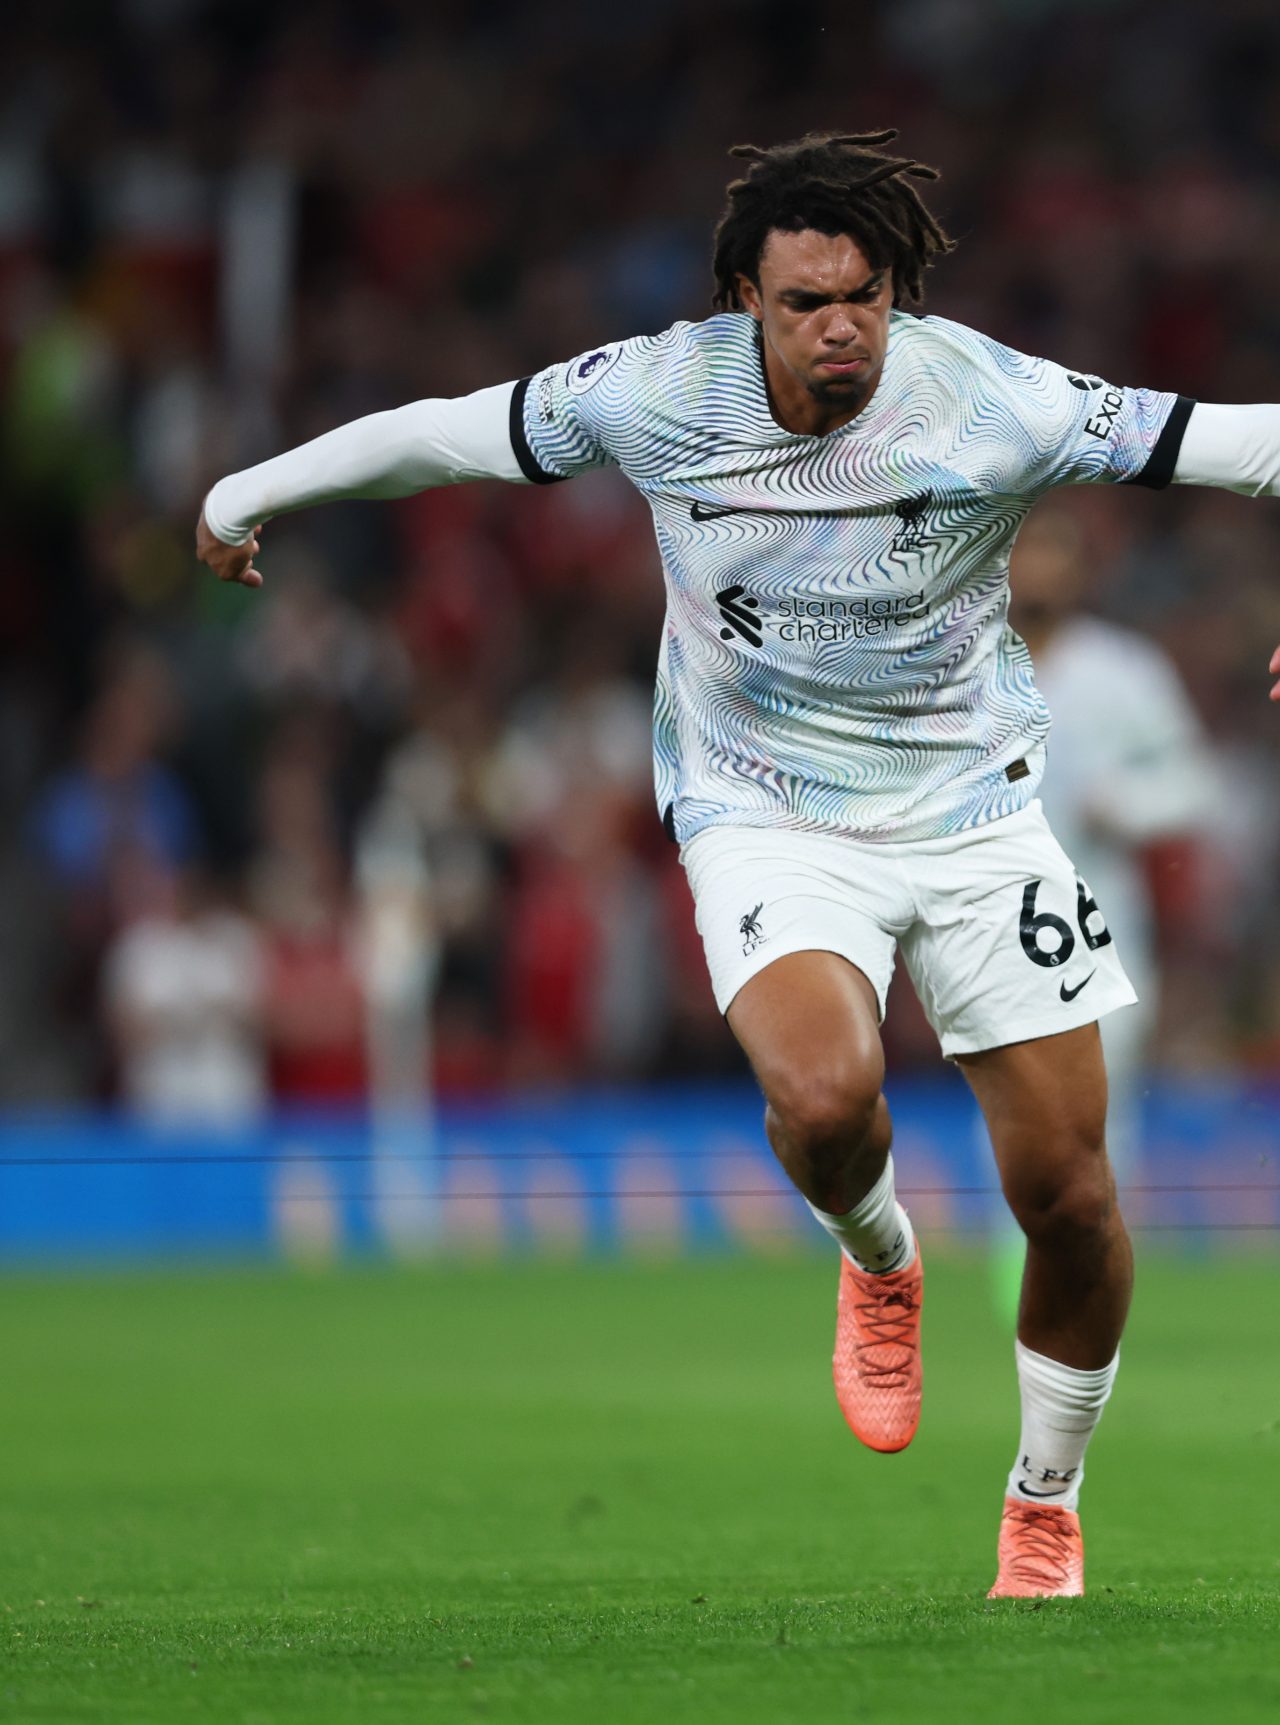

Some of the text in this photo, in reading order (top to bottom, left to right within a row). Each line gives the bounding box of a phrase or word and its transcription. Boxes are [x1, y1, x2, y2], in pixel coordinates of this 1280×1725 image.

[777, 589, 925, 618] standard
[778, 602, 931, 642] chartered
[1019, 879, 1113, 968] 66
